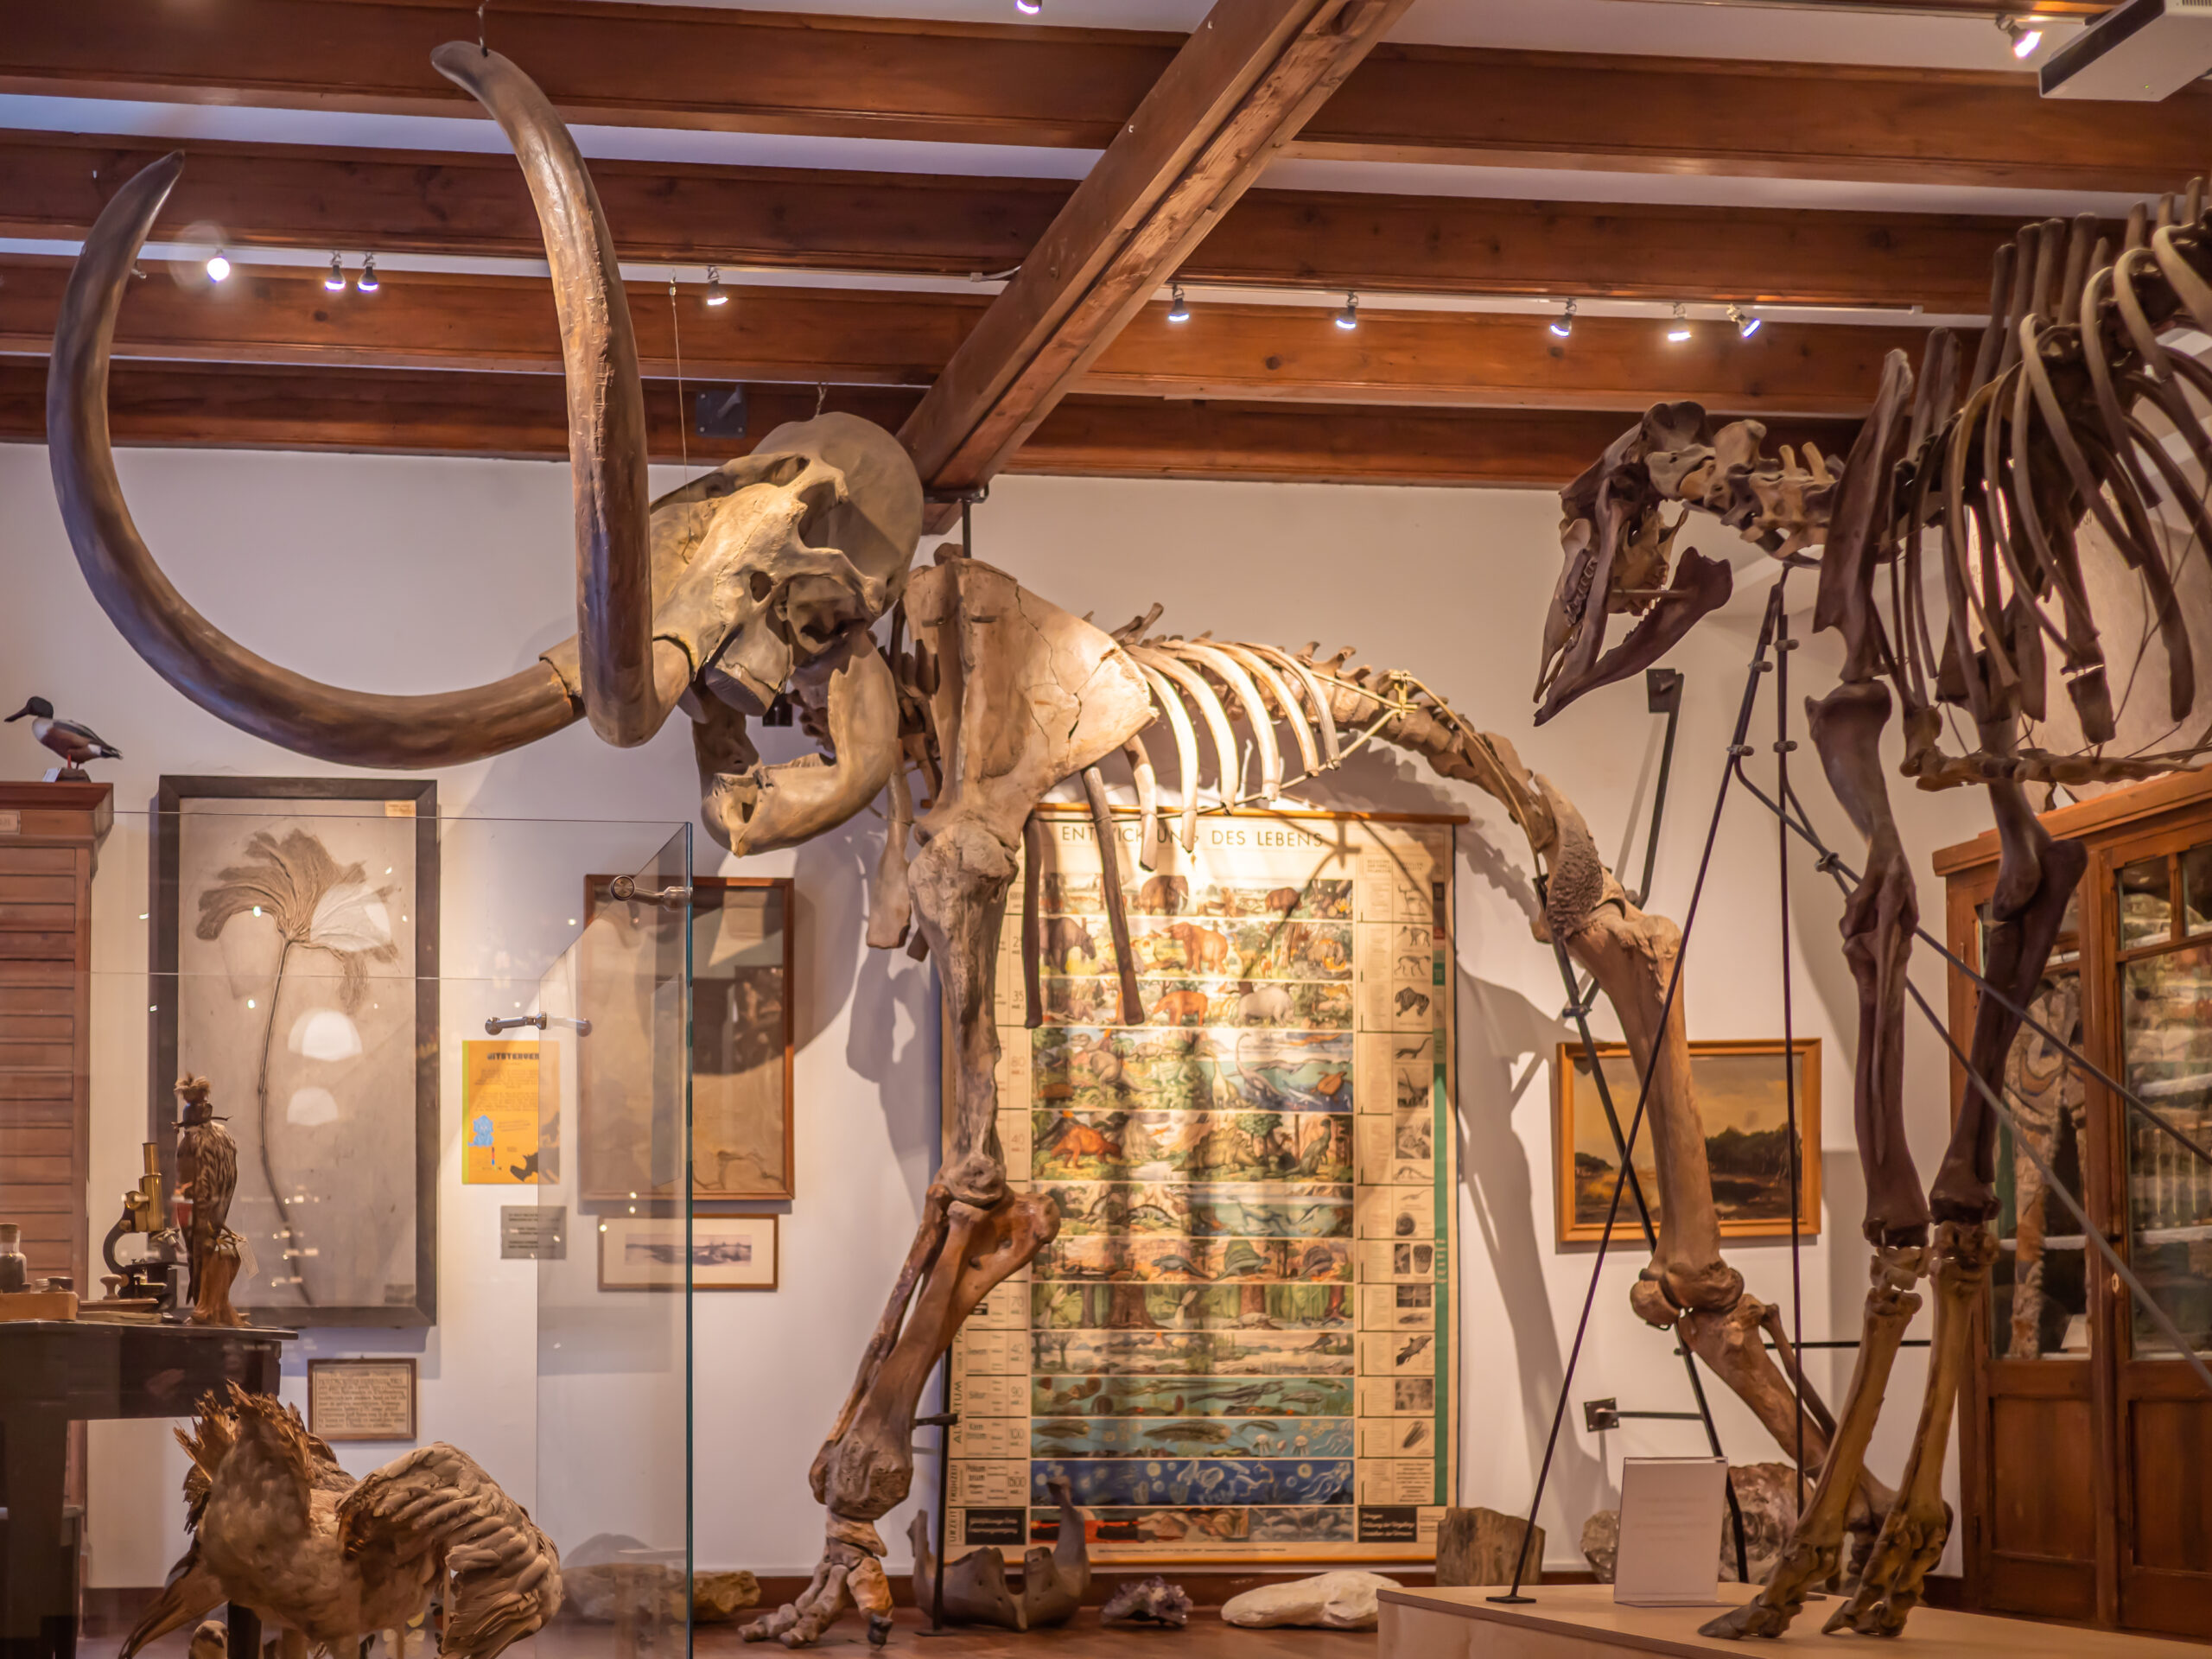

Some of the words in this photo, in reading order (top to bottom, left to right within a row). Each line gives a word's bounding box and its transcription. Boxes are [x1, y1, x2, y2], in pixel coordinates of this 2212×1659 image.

[1062, 826, 1199, 844] ENTICKUN
[1211, 830, 1246, 846] DES
[1257, 830, 1324, 848] LEBENS
